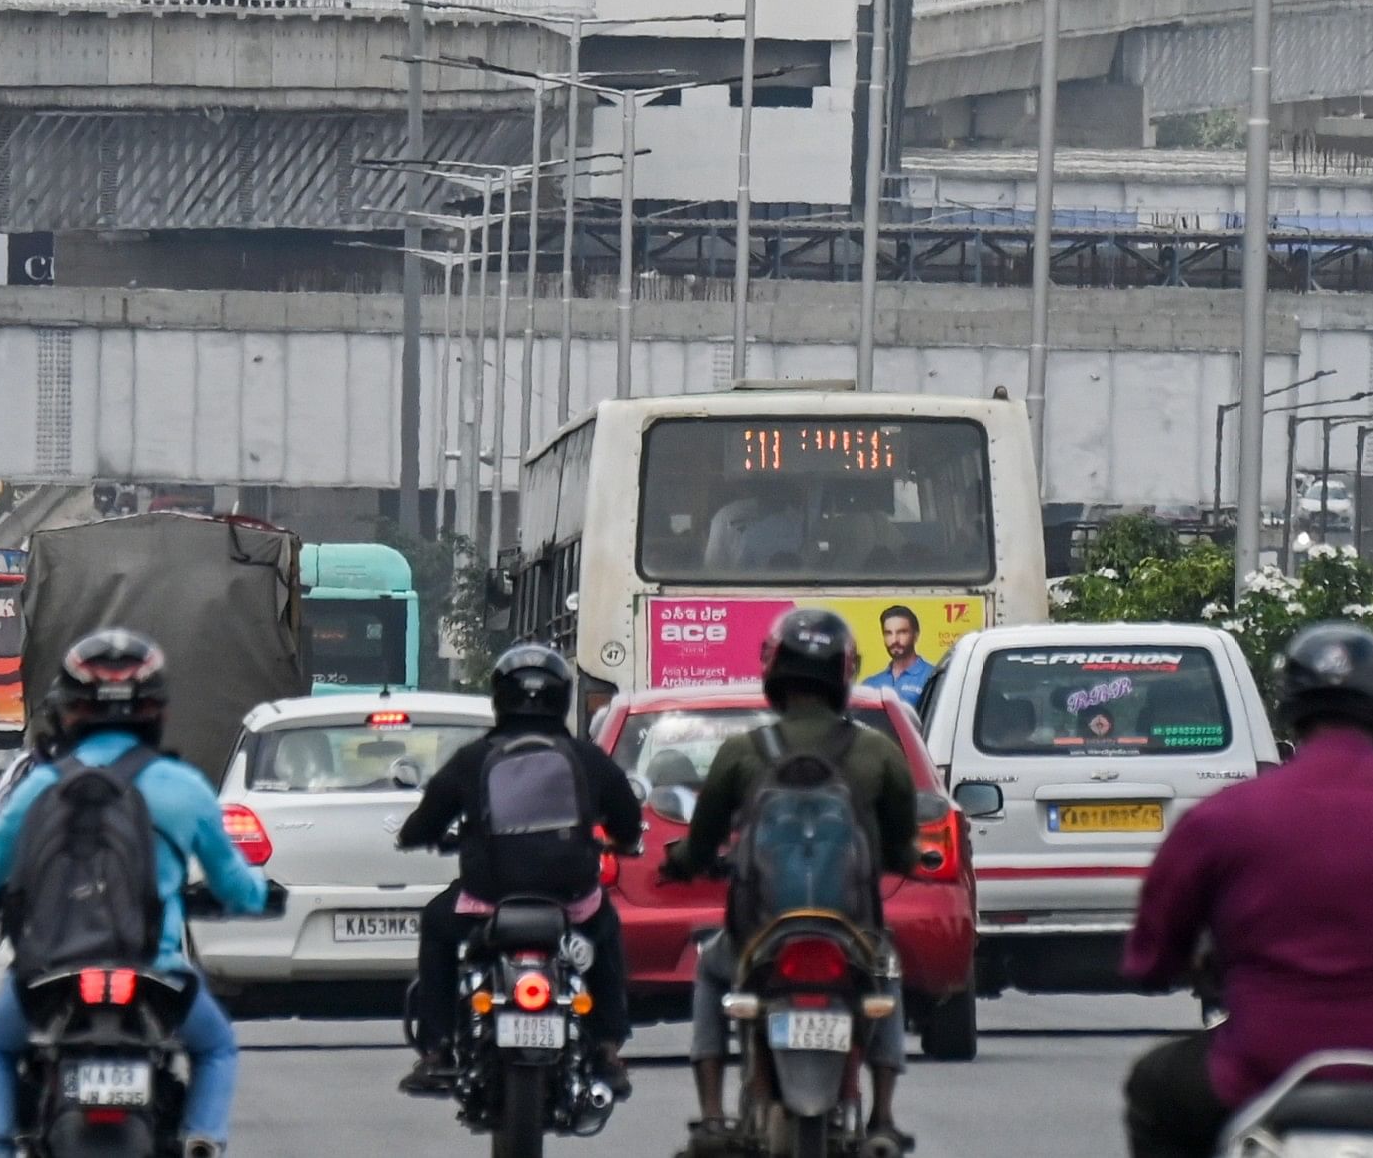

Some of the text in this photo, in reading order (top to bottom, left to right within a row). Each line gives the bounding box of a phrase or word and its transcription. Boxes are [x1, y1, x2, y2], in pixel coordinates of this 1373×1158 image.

[660, 623, 727, 642] ace
[661, 667, 726, 678] Asia's Largest
